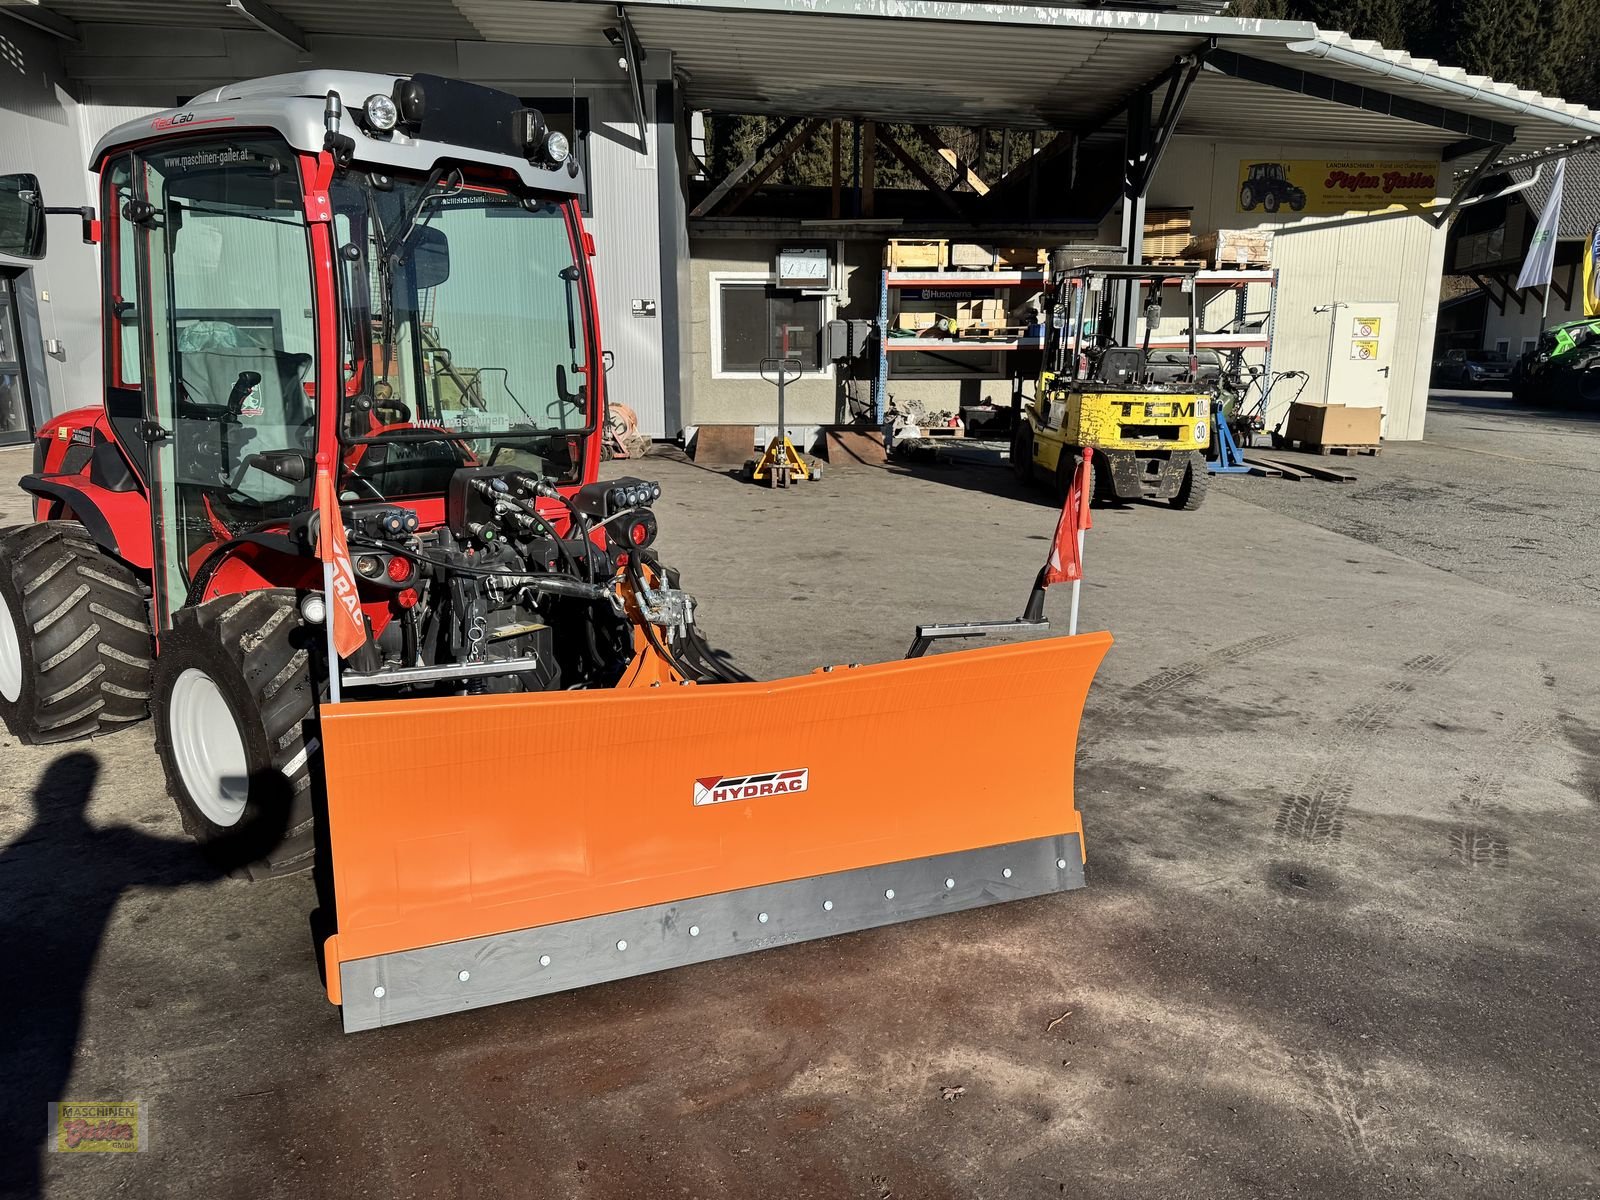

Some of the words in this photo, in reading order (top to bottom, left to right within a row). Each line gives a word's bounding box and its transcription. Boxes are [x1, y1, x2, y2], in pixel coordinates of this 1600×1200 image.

[1324, 171, 1380, 192] Stefan
[1382, 171, 1435, 193] Gailer
[930, 290, 972, 299] Husqvarna
[1111, 401, 1194, 417] TCM
[1196, 425, 1205, 439] 30
[713, 779, 803, 802] HYDRAC
